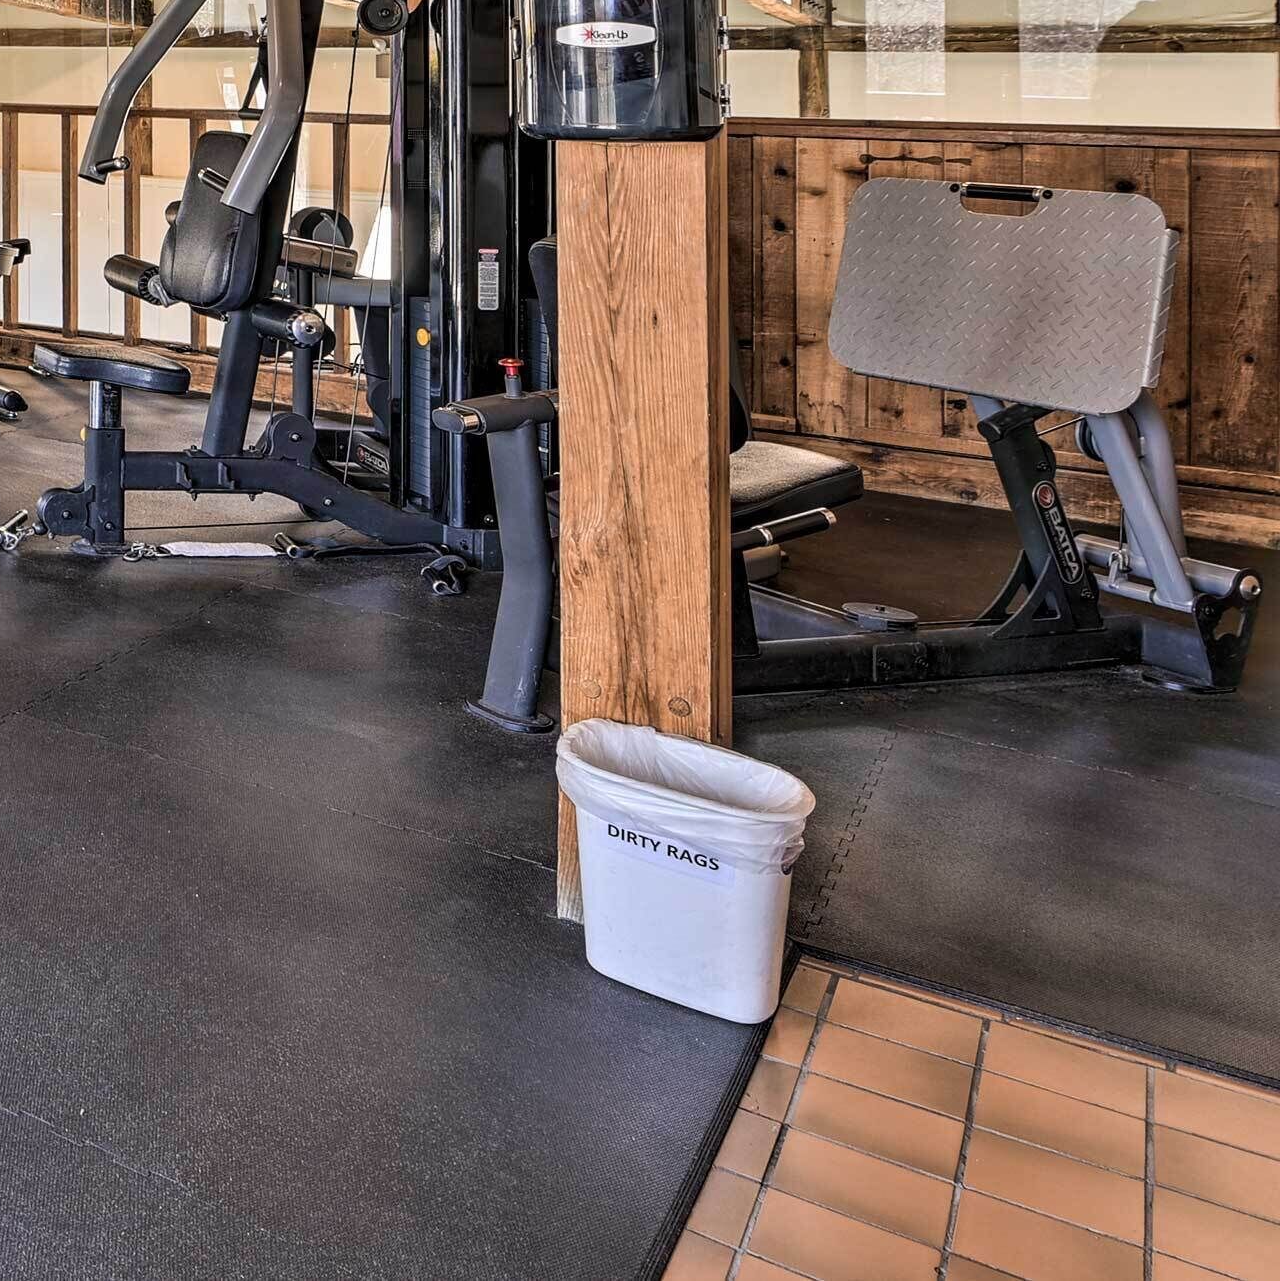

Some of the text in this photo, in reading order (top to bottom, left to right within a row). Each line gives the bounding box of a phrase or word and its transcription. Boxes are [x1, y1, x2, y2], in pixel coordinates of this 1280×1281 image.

[590, 30, 629, 41] Klean-Up
[1049, 506, 1080, 579] BATCA
[607, 823, 720, 871] DIRTY RAGS
